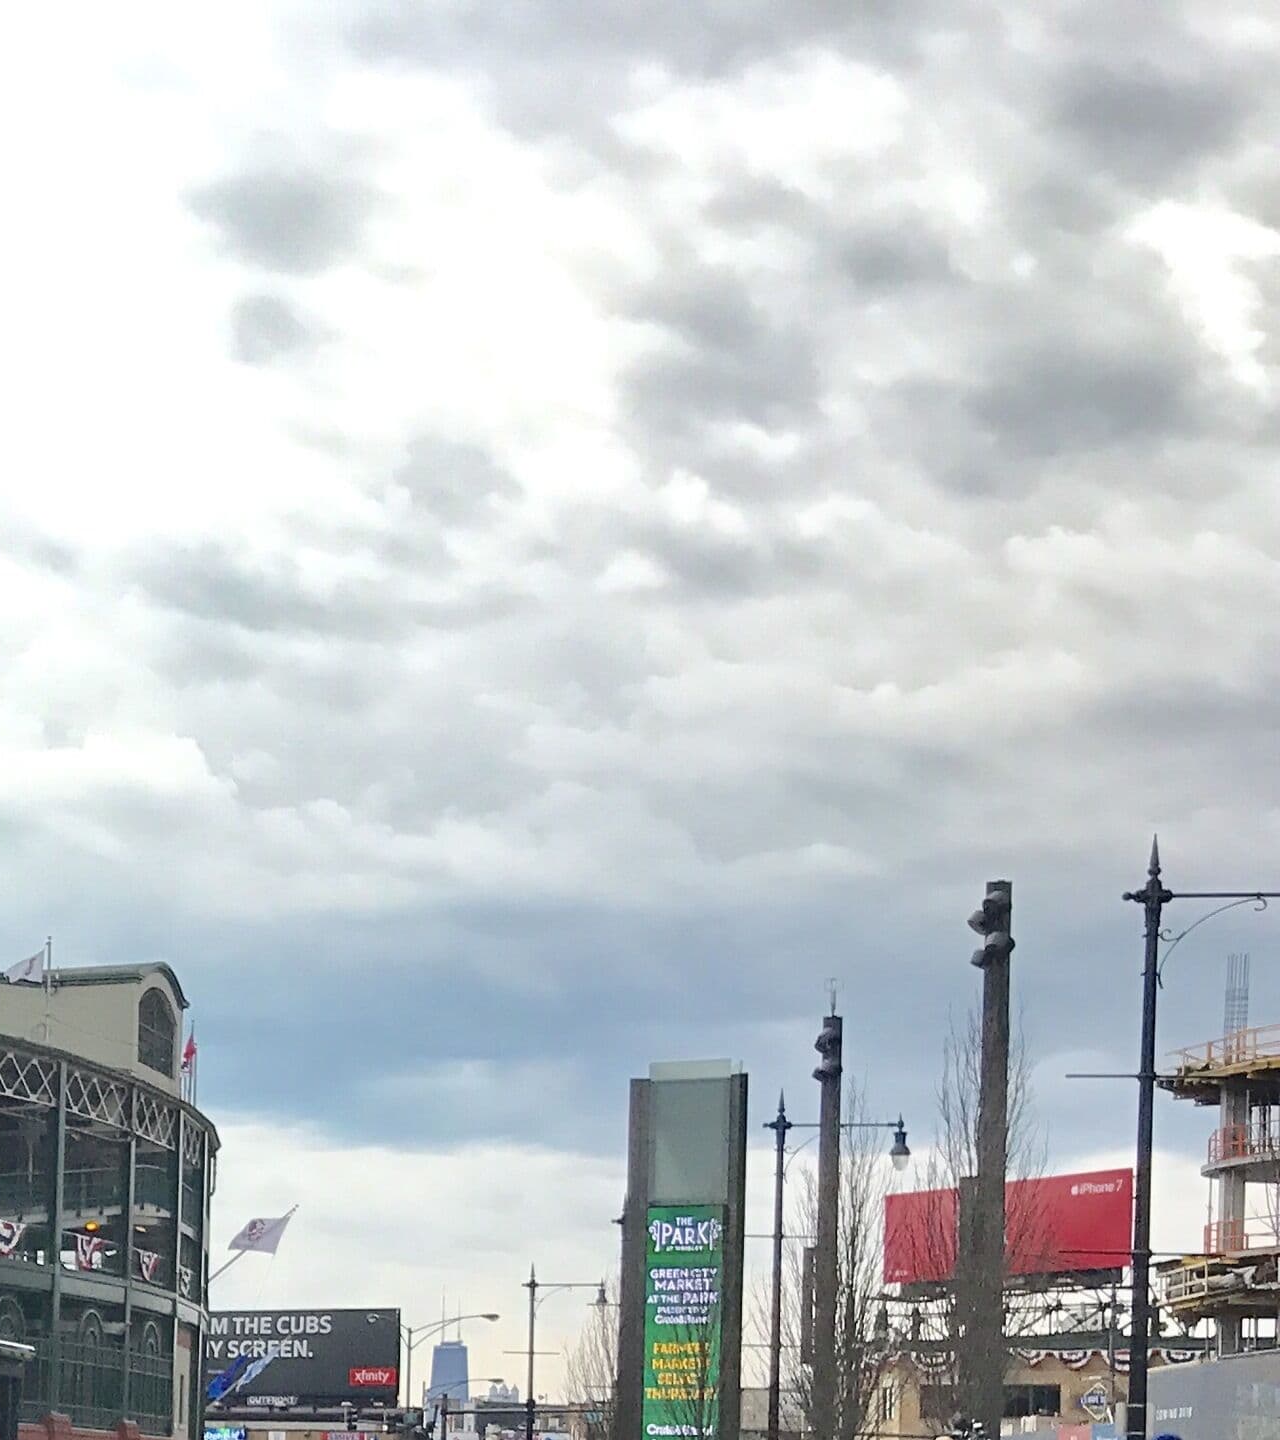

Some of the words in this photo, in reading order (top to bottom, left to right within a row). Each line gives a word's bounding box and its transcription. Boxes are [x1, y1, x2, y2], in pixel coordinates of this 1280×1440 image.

[1080, 1182, 1115, 1194] iPhone
[1116, 1179, 1123, 1192] 7
[676, 1217, 693, 1226] THE
[661, 1222, 709, 1245] PARK
[650, 1269, 688, 1279] GREEN
[654, 1279, 713, 1291] MARKET
[647, 1295, 660, 1304] AT
[660, 1295, 679, 1304] THE
[682, 1292, 718, 1304] PARK
[208, 1316, 228, 1335] M
[232, 1316, 272, 1335] THE
[276, 1315, 333, 1335] CUBS
[206, 1340, 223, 1359] Y
[227, 1339, 314, 1359] SCREEN.
[354, 1371, 391, 1383] xfinity
